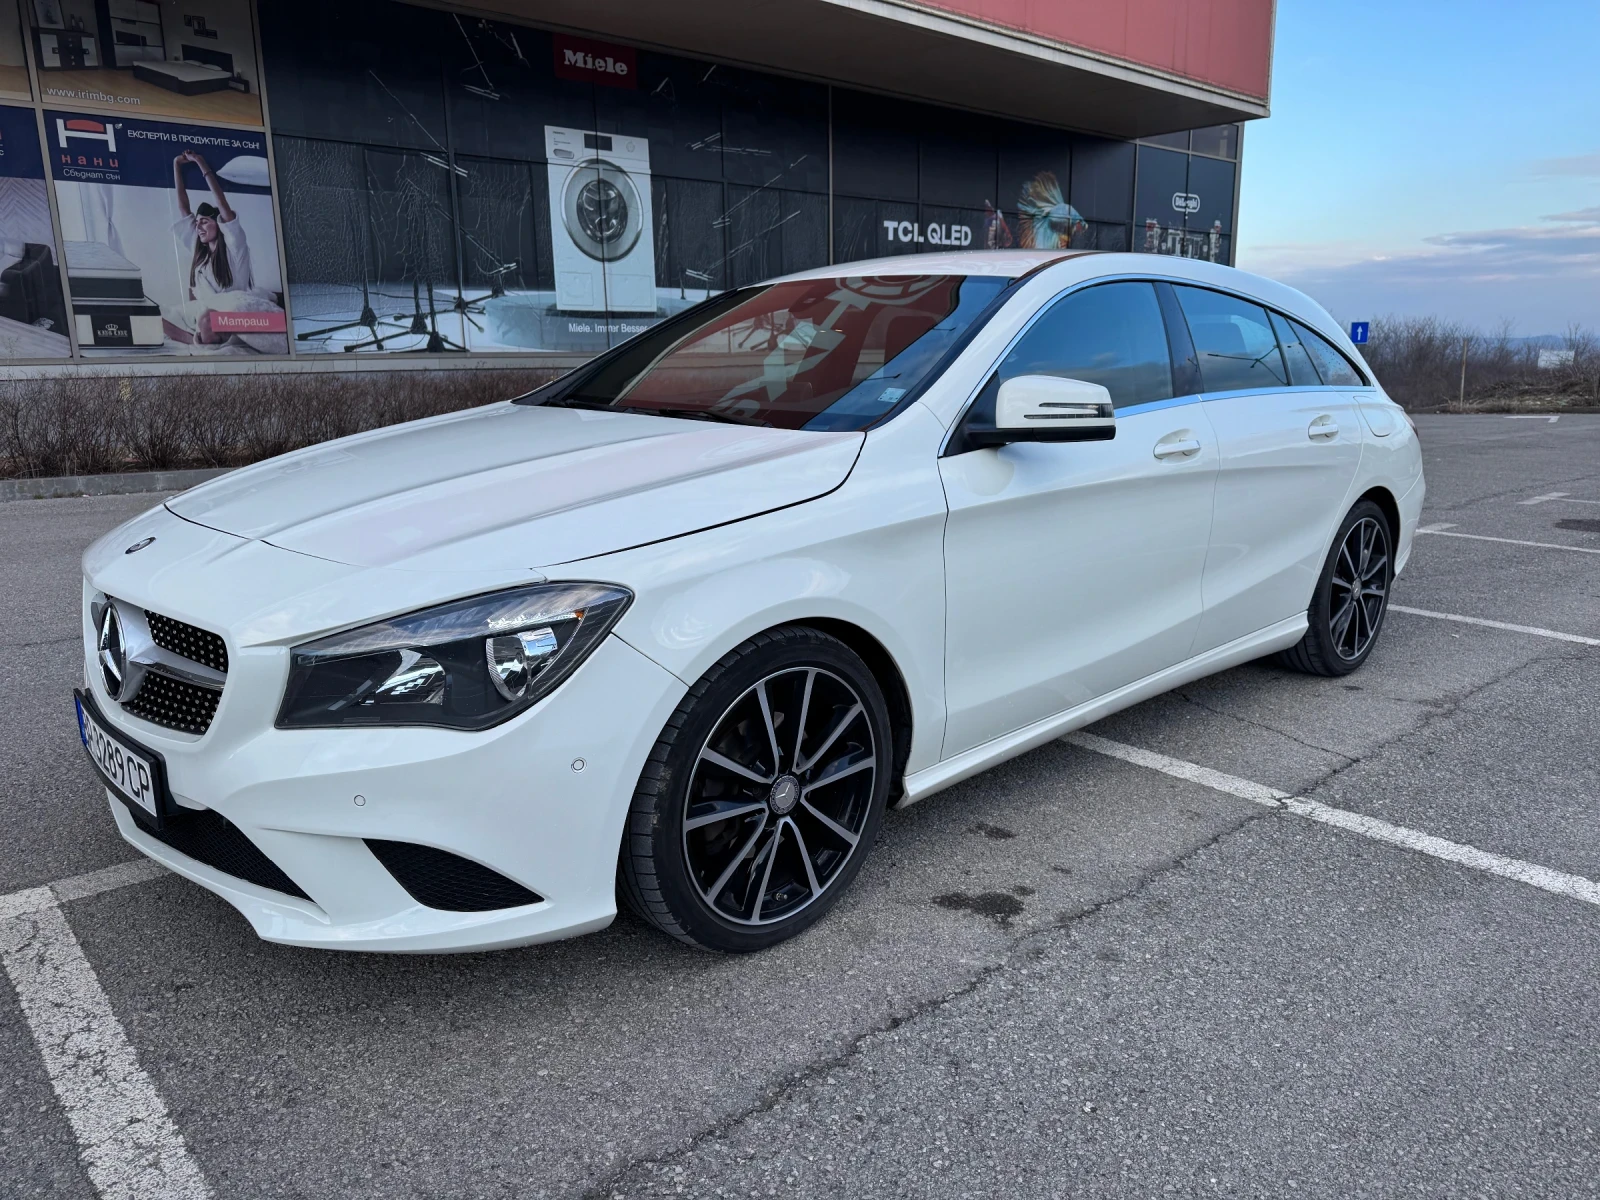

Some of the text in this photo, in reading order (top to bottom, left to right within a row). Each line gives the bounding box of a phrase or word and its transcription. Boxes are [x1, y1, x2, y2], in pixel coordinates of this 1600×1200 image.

[563, 48, 628, 76] Miele
[46, 87, 141, 105] www.irimbg.com
[127, 129, 170, 142] ЕКСПЕРТИ
[171, 134, 178, 142] В
[178, 134, 230, 147] ПРОДУКТИТЕ
[231, 140, 242, 148] ЗА
[63, 168, 104, 179] Сбъднат
[883, 220, 972, 247] TCL QLED
[218, 316, 270, 328] Матраци
[568, 322, 593, 333] Miele.
[127, 755, 150, 803] CP
